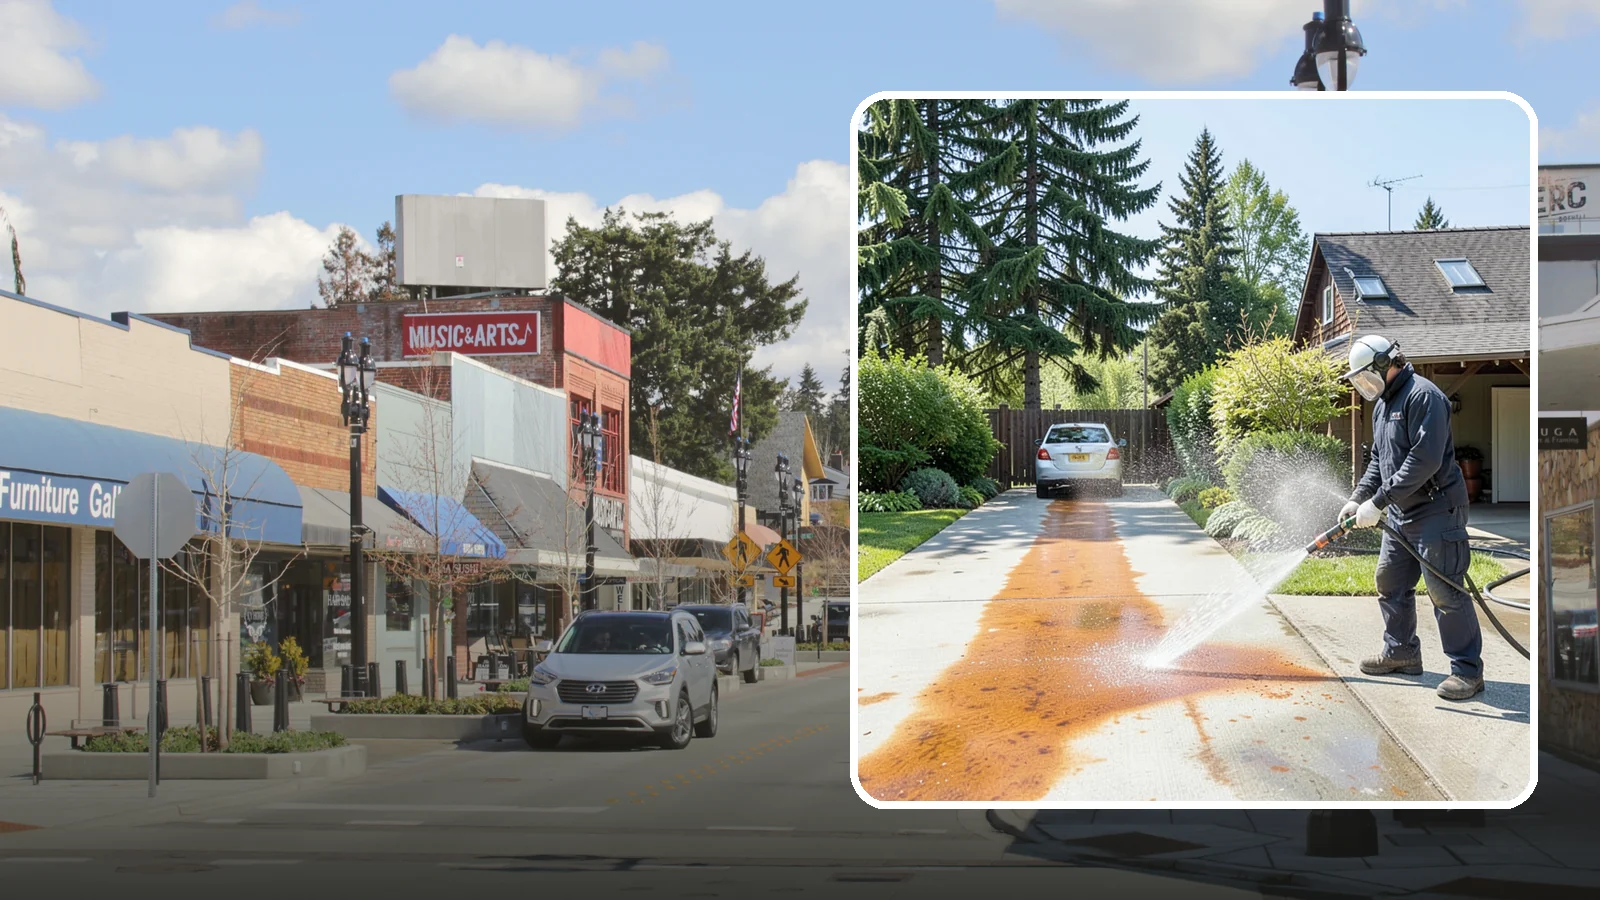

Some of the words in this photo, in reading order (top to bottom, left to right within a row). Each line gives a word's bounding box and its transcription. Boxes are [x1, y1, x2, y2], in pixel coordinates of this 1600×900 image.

[0, 472, 79, 515] Furniture
[90, 483, 121, 518] Gal
[453, 563, 479, 574] SUSHI
